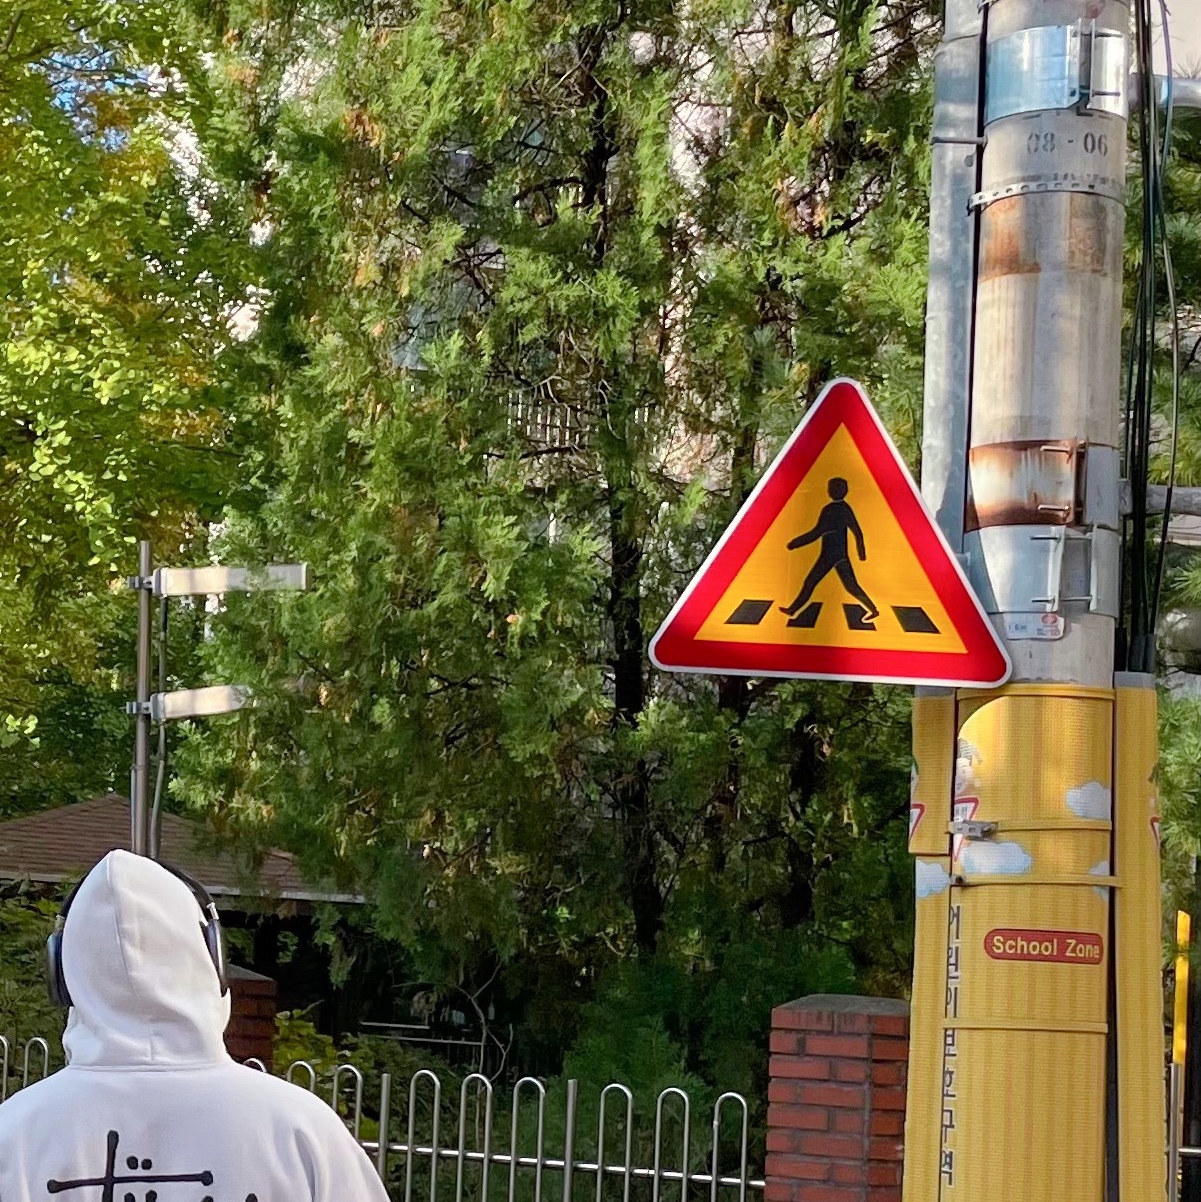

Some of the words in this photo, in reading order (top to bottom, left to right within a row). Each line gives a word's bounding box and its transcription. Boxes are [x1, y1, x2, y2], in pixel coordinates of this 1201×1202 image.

[1027, 132, 1056, 154] 08
[1083, 132, 1108, 156] 06
[992, 935, 1057, 956] School
[1065, 939, 1100, 959] Zone
